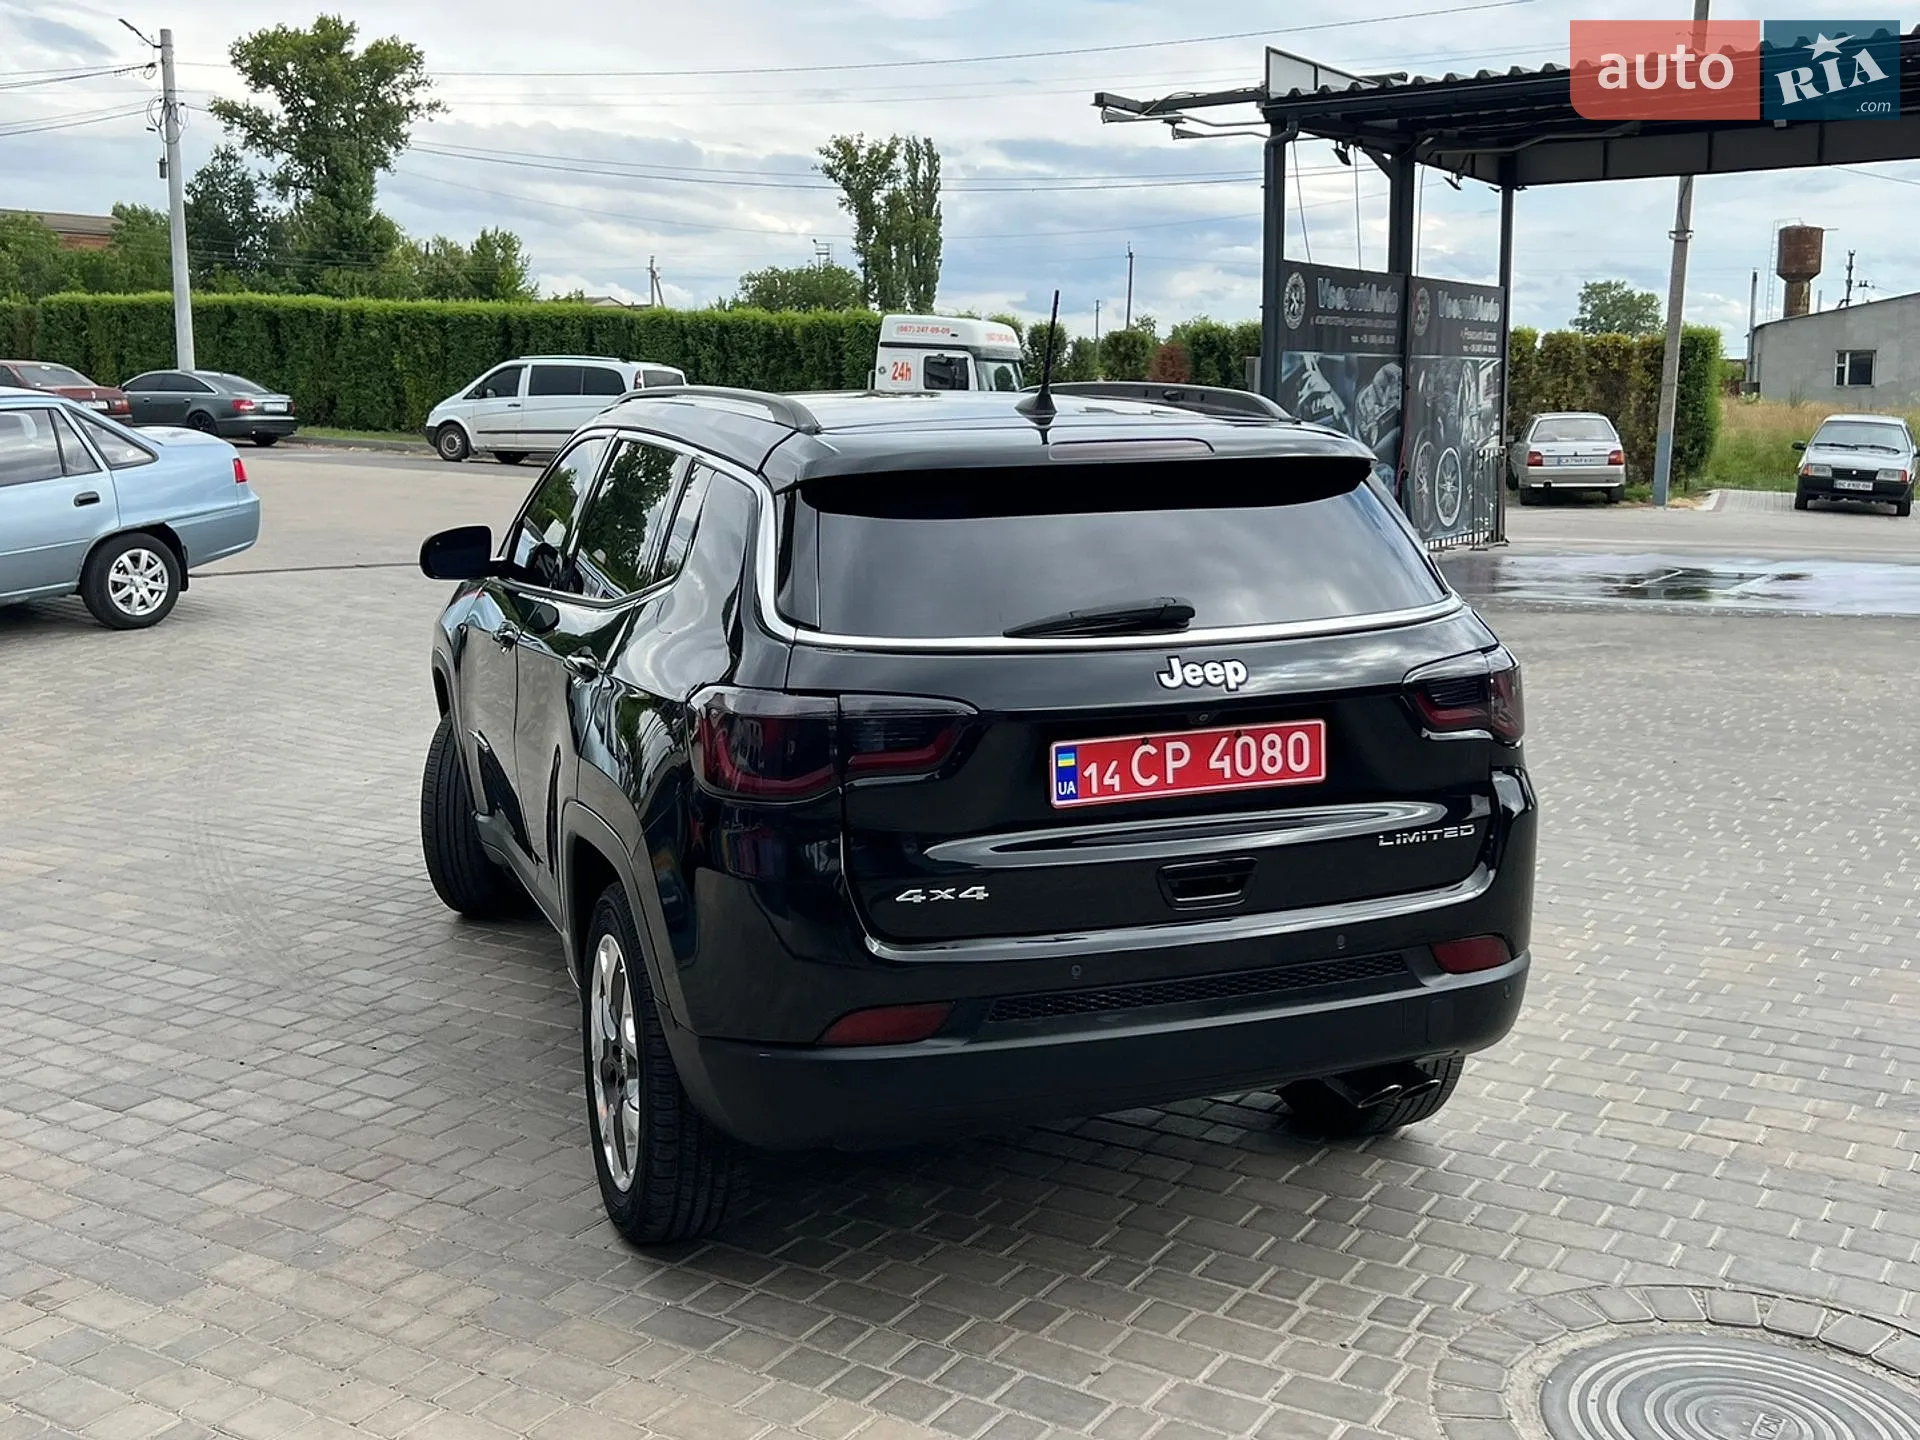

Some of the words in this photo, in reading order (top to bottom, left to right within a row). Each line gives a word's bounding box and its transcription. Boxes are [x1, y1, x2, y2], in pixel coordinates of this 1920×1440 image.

[891, 361, 912, 382] 24h
[1157, 657, 1248, 691] Jeep
[1082, 760, 1120, 794] 14
[1130, 742, 1191, 787] CP
[1208, 730, 1311, 779] 4080
[1058, 782, 1076, 796] UA
[1378, 824, 1475, 847] LIMITED
